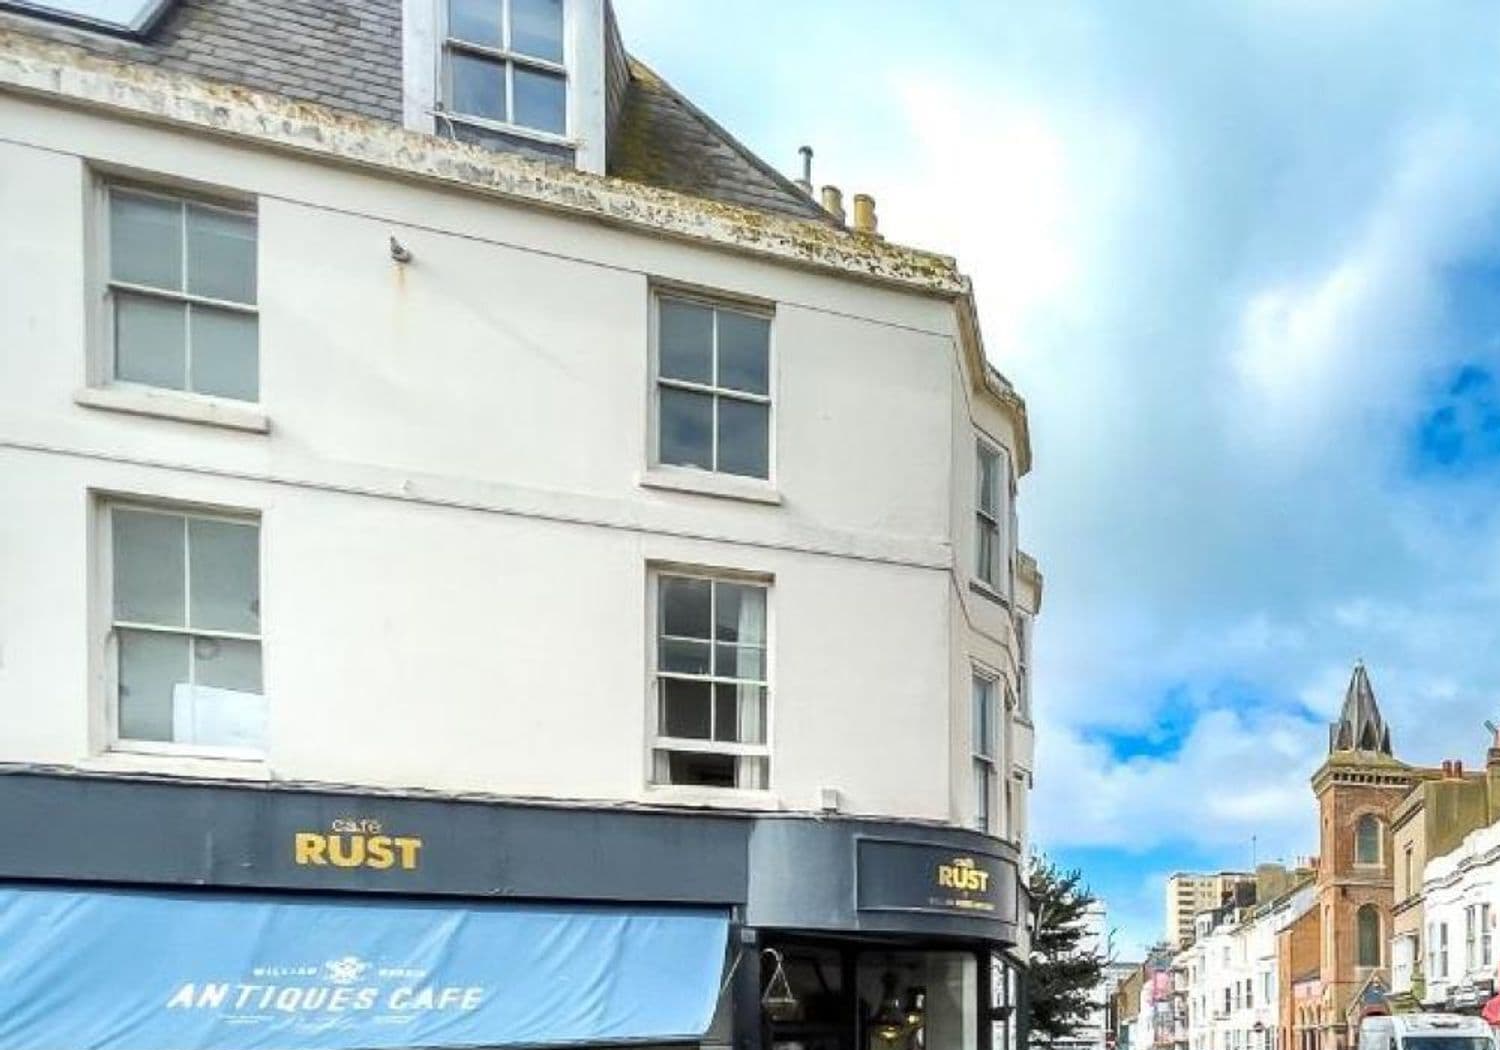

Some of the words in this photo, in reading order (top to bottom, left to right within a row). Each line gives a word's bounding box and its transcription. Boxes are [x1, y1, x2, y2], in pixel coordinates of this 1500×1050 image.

[295, 832, 422, 870] RUST
[939, 865, 989, 892] RUST
[166, 982, 380, 1013] ANTIQUES
[388, 986, 484, 1010] CAFE
